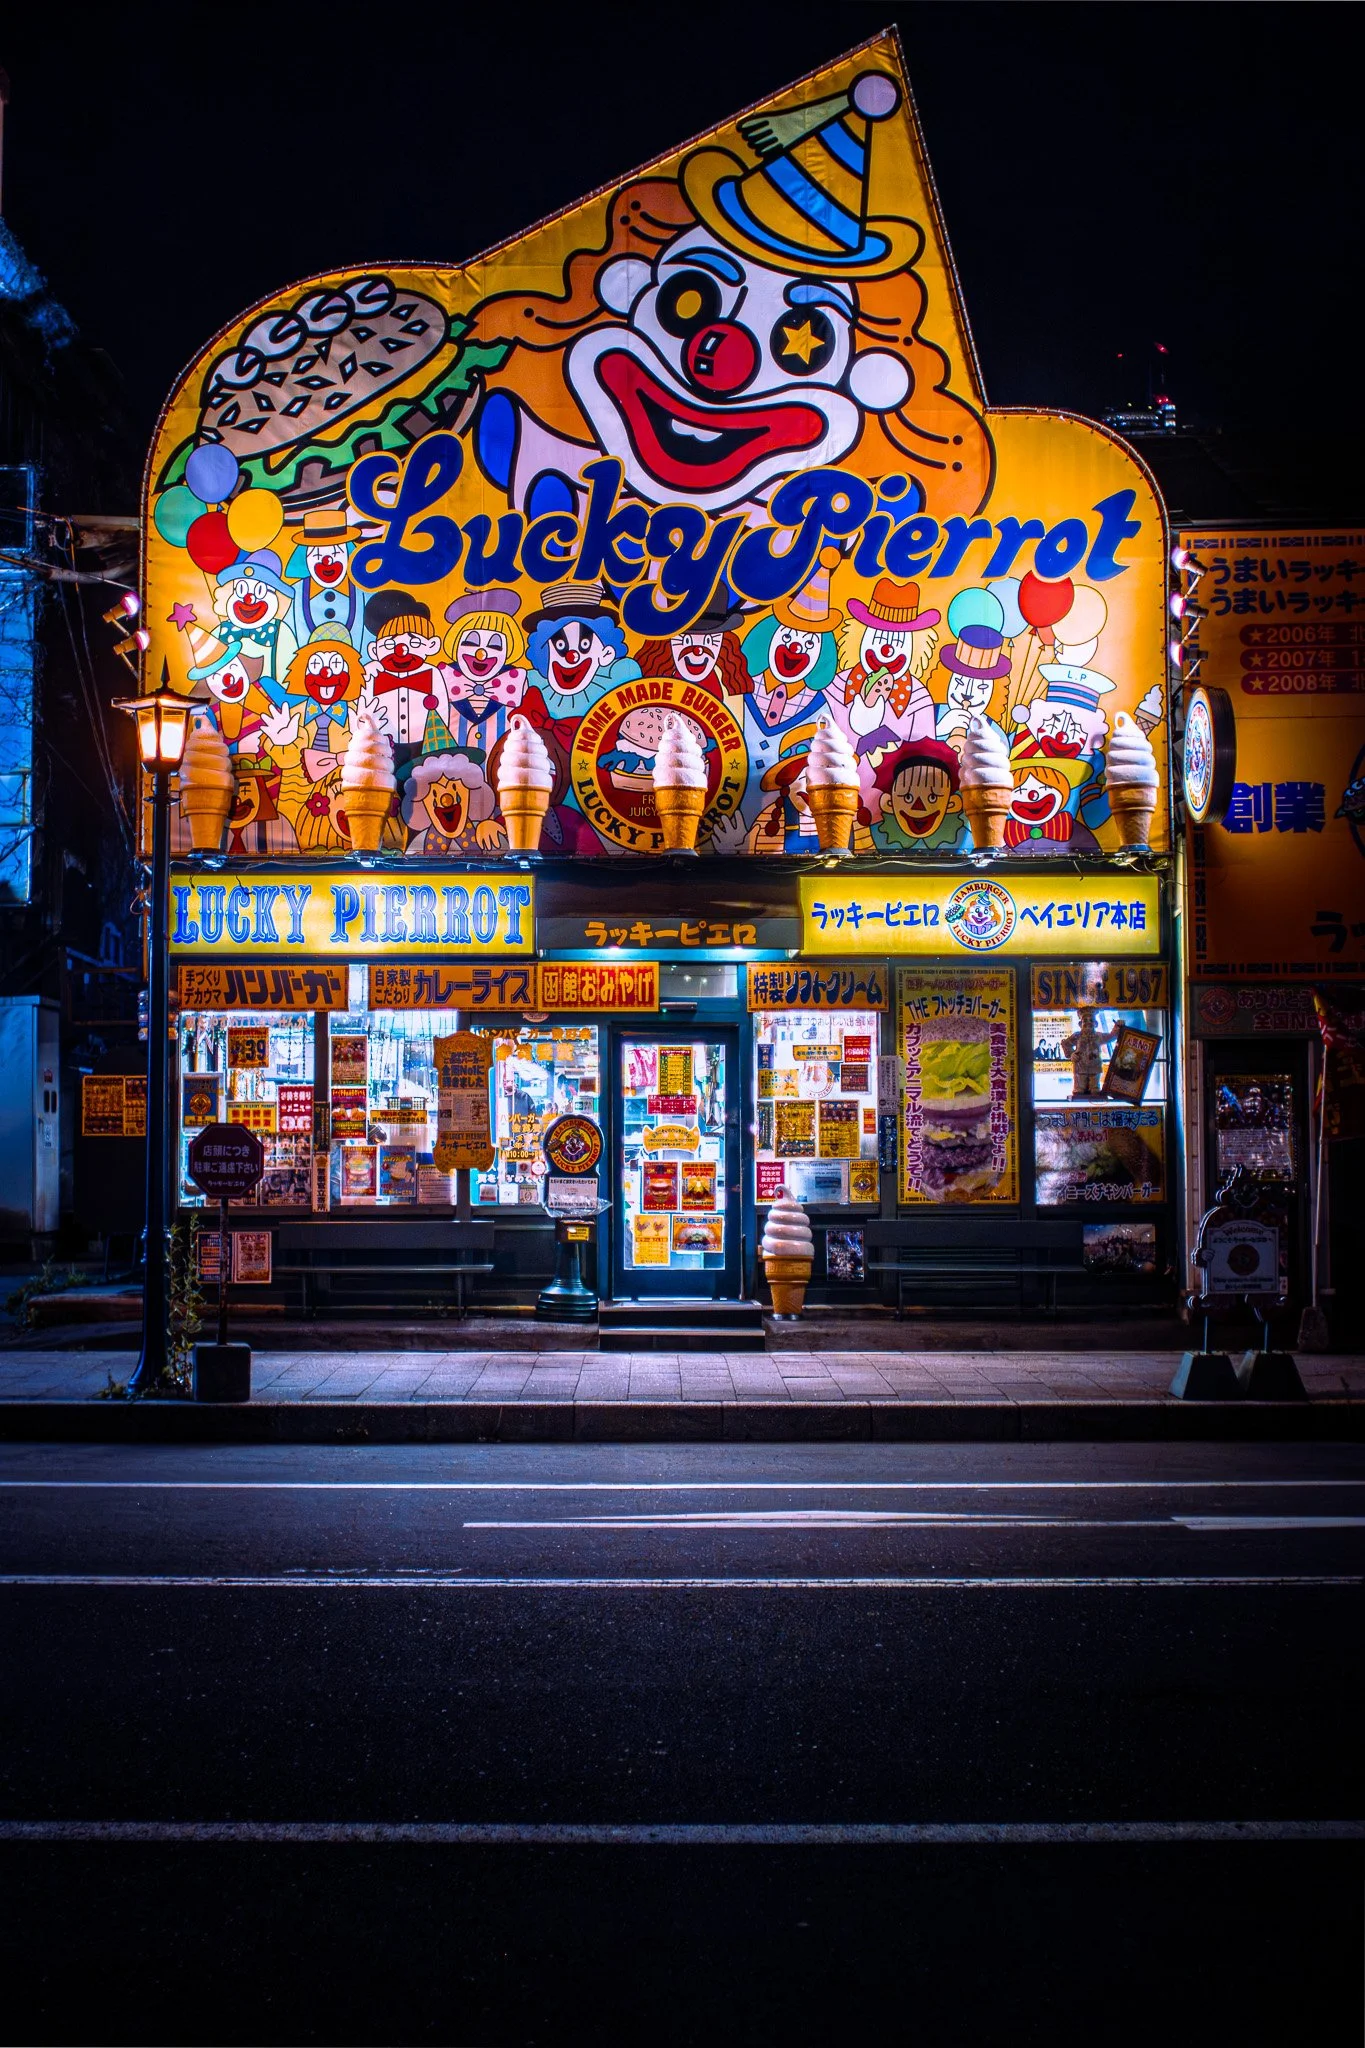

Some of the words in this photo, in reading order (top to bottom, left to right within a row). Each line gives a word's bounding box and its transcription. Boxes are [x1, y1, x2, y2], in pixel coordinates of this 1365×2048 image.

[348, 433, 746, 636] Lucky
[730, 468, 1142, 601] Pierrot
[1267, 626, 1336, 643] 2006年
[1267, 650, 1337, 668] 2007年
[1268, 674, 1338, 692] 2008年
[576, 701, 617, 755] HOME
[615, 682, 674, 710] MADE
[680, 683, 743, 754] BURGER
[576, 777, 646, 845] LUCKY
[1220, 781, 1327, 834] 創業
[954, 882, 1010, 905] HAMBURGER
[172, 884, 312, 945] LUCKY
[329, 884, 531, 945] PIERROT
[810, 901, 940, 930] ラッキーピエロ
[952, 924, 983, 948] LUCKY
[985, 910, 1014, 948] PIERROT
[1019, 900, 1147, 930] ベイエリア本店
[583, 921, 757, 947] ラッキーピエロ
[184, 970, 221, 987] 手づくり
[224, 969, 342, 1005] ハンバーガー
[374, 969, 412, 988] 自家製
[413, 969, 531, 1005] カレーライス
[543, 969, 654, 1004] 函館おみやげ
[753, 970, 883, 1006] 特製ソフトクリーム
[1038, 969, 1110, 1005] SINCE
[1115, 968, 1163, 1004] 1987
[184, 988, 222, 1006] デカウマ
[374, 989, 411, 1005] こだわり
[905, 999, 931, 1022] THE
[932, 993, 1007, 1019] フトッチョバーガー
[1253, 1010, 1318, 1032] 全国No
[245, 1039, 266, 1061] 39
[203, 1145, 251, 1158] 店頭につき
